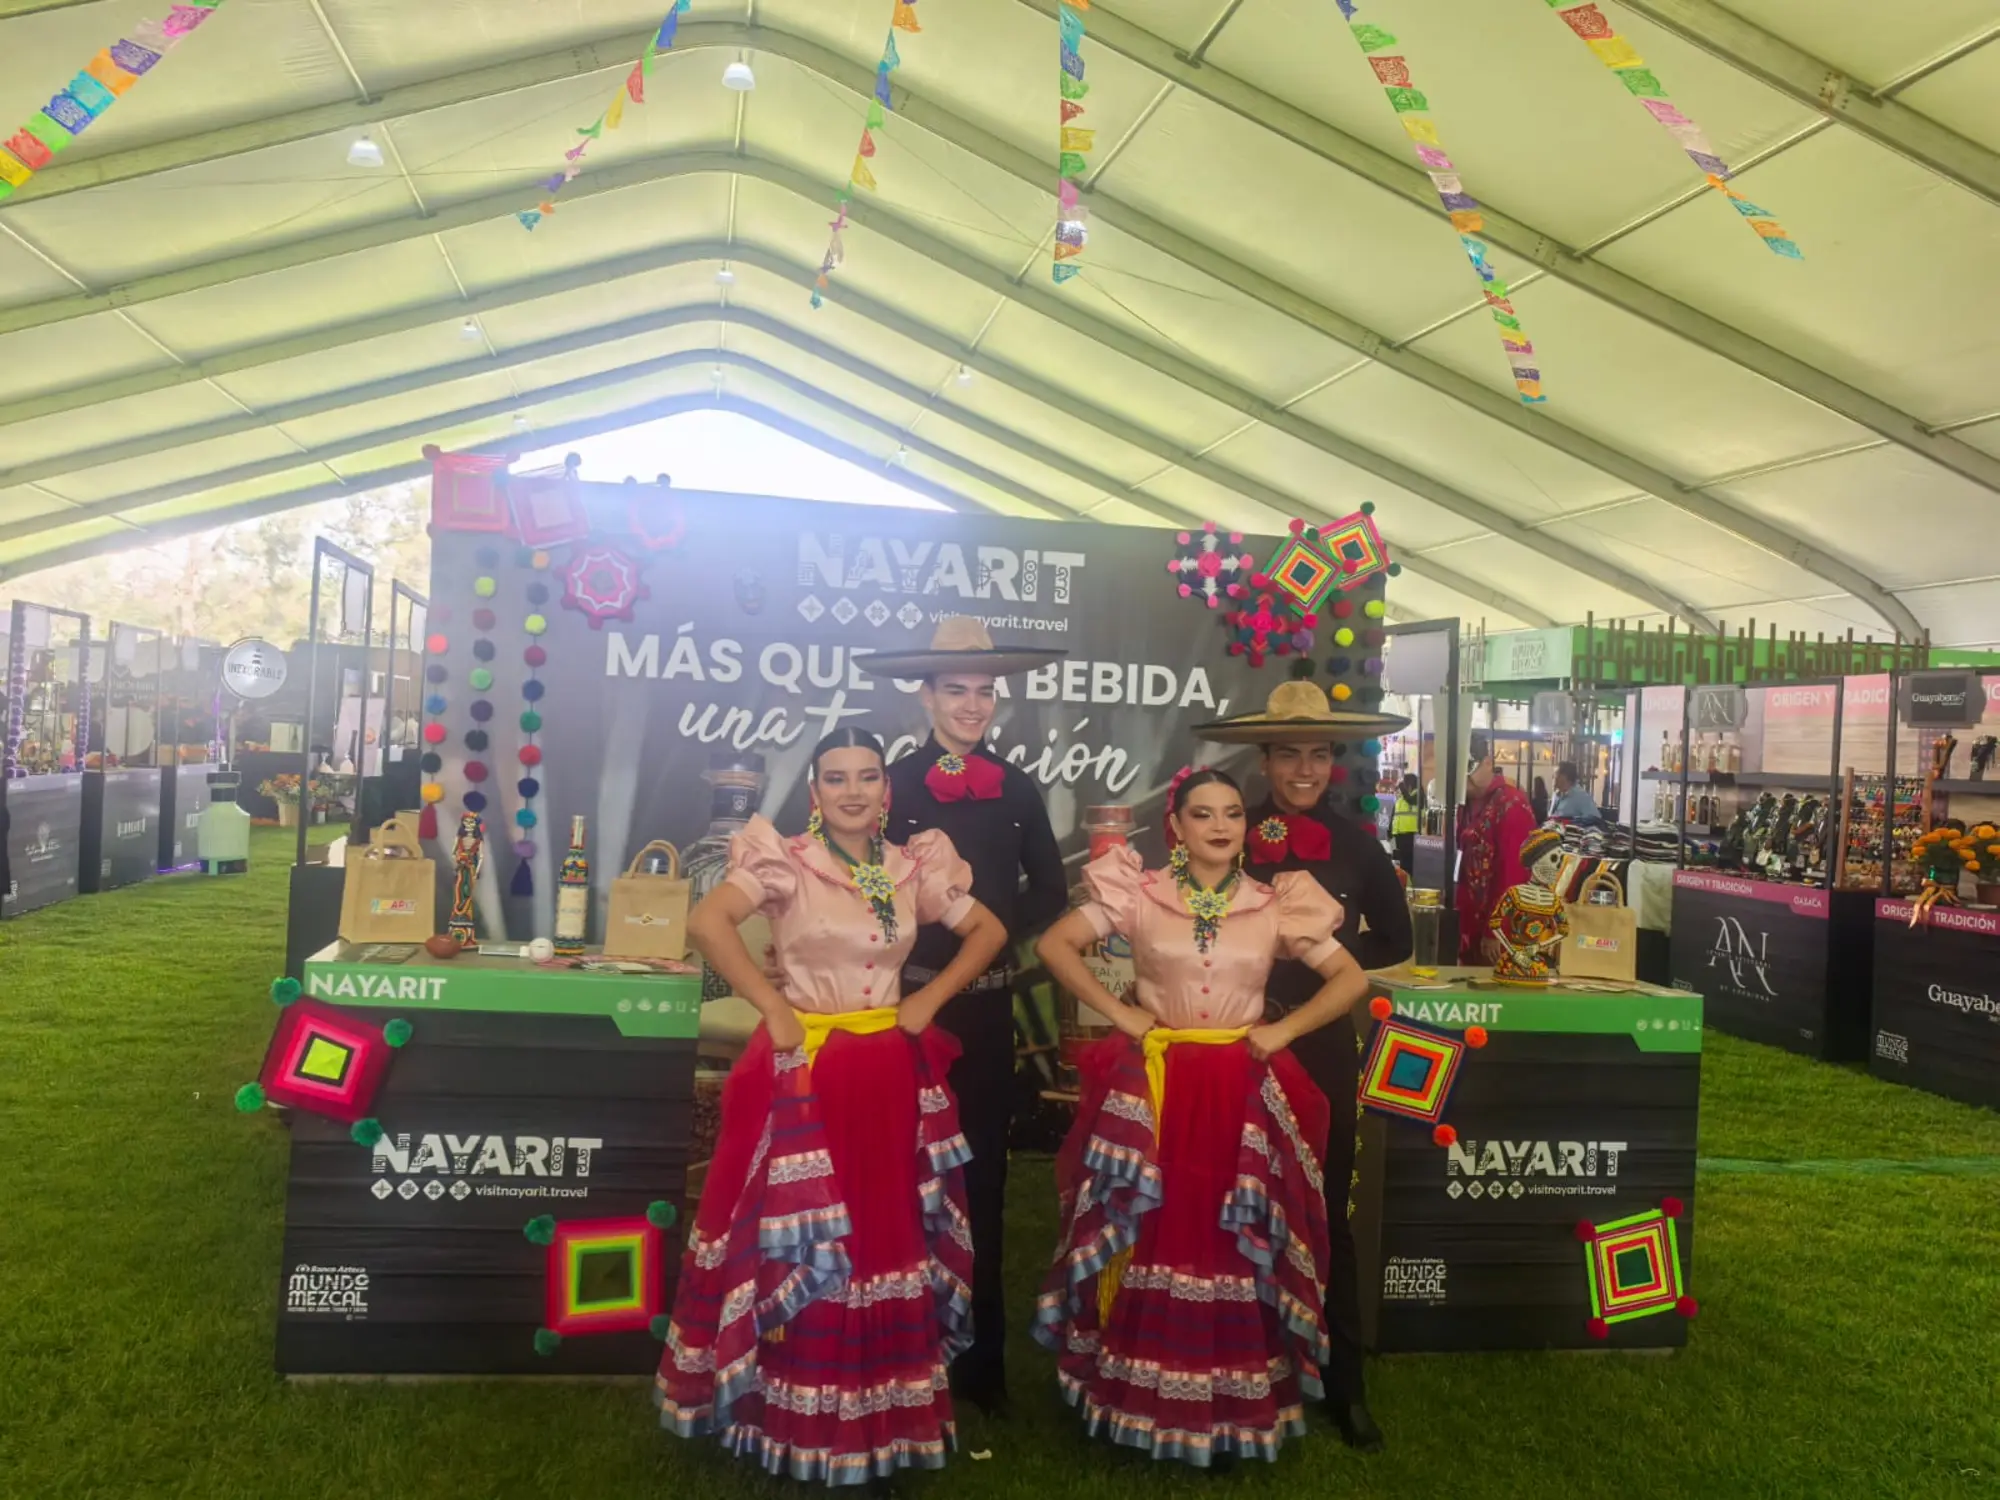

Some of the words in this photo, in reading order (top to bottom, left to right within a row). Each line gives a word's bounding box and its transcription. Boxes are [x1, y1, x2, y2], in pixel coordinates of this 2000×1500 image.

[797, 532, 1085, 604] NAYARIT
[605, 621, 744, 683] MÁS
[758, 642, 876, 693] QUE
[1026, 660, 1229, 717] BEBIDA,
[678, 702, 805, 750] una
[1881, 904, 1921, 919] ORIGE
[1934, 910, 1997, 931] TRADICIÓN
[309, 971, 448, 1001] NAYARIT
[1396, 1000, 1503, 1024] NAYARIT
[371, 1133, 603, 1178] NAYARIT
[1447, 1140, 1628, 1177] NAYARIT
[475, 1186, 588, 1199] visitnayarit.travel
[1528, 1184, 1616, 1196] visitnayarit.travel
[288, 1273, 370, 1291] MUNDO
[1384, 1264, 1446, 1280] MUNDO
[287, 1290, 369, 1307] MEZCAL
[1383, 1279, 1446, 1293] MEZCAL
